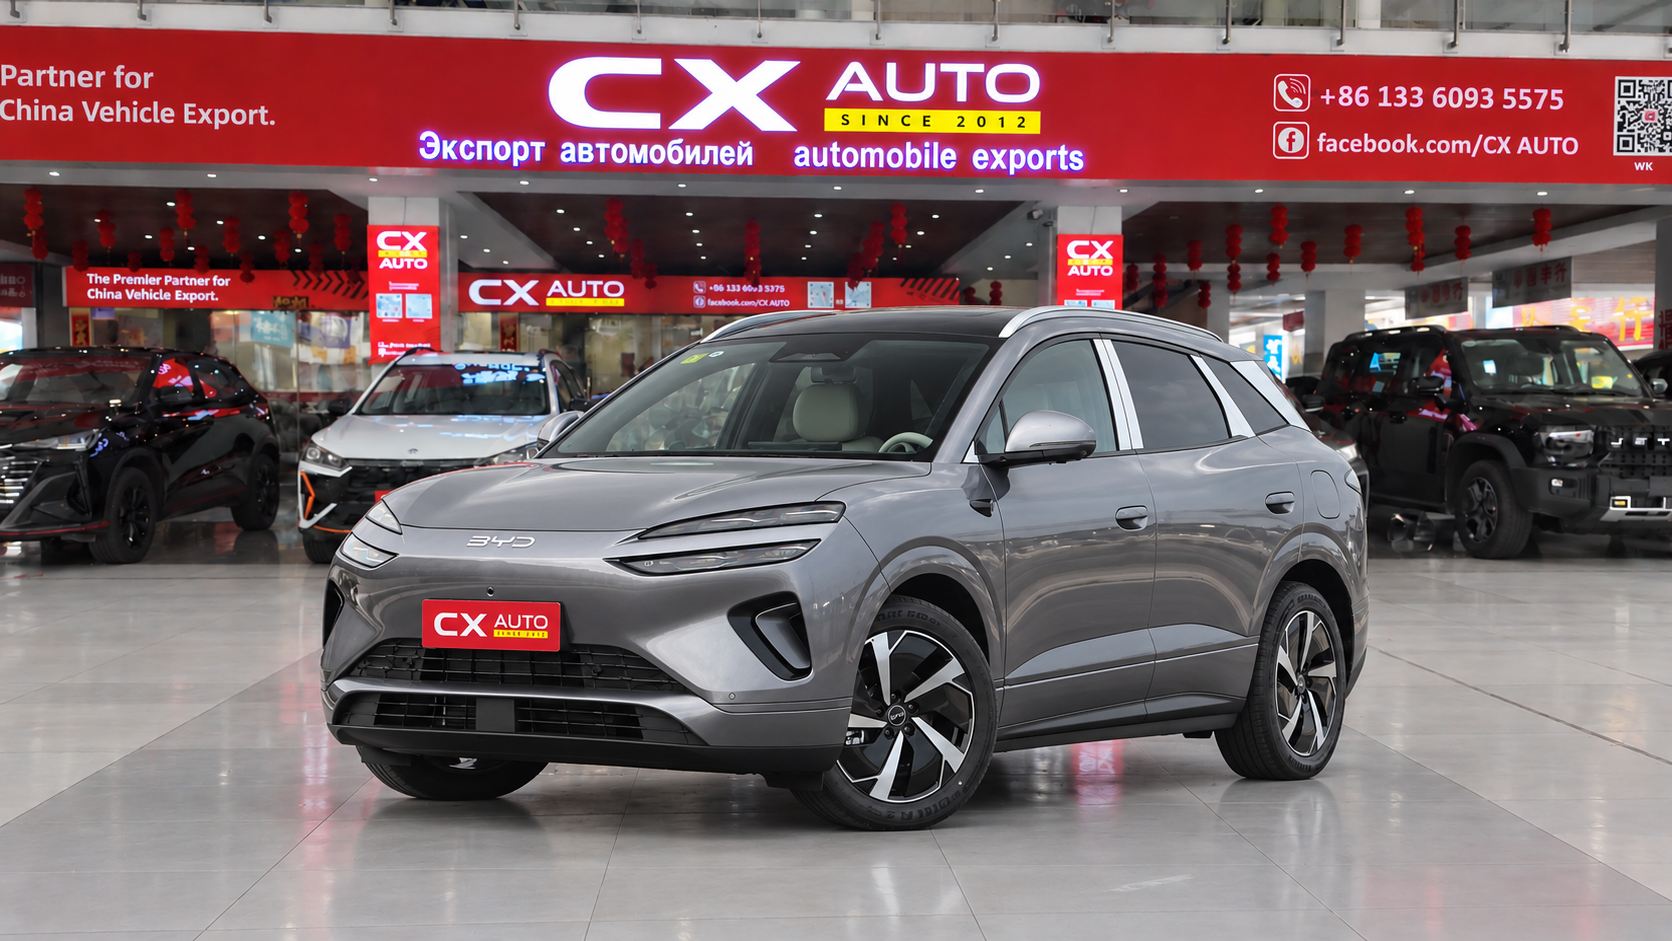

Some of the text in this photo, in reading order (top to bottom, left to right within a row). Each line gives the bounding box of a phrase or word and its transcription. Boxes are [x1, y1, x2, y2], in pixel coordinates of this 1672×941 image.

[0, 64, 154, 89] Partner for
[826, 62, 1040, 103] AUTO
[549, 57, 800, 132] CX
[1321, 86, 1564, 110] +86 133 6093 5575
[0, 98, 276, 130] China Vehicle Export.
[841, 114, 1027, 129] SINCE 2012
[419, 132, 754, 167] Экспорт автомобилей
[1317, 133, 1579, 157] facebook.com/CX AUTO
[794, 142, 1084, 176] automobile exports
[1634, 162, 1653, 171] WK
[377, 231, 427, 251] CX
[1067, 240, 1114, 259] CX
[379, 258, 428, 269] AUTO
[1067, 265, 1114, 276] AUTO
[87, 273, 110, 285] The
[164, 276, 210, 287] Partner
[212, 275, 231, 287] for
[547, 280, 625, 297] AUTO
[87, 288, 219, 303] China Vehicle Export.
[468, 279, 540, 306] CX
[466, 535, 536, 548] BYD
[434, 612, 487, 637] CX
[494, 614, 548, 630] AUTO
